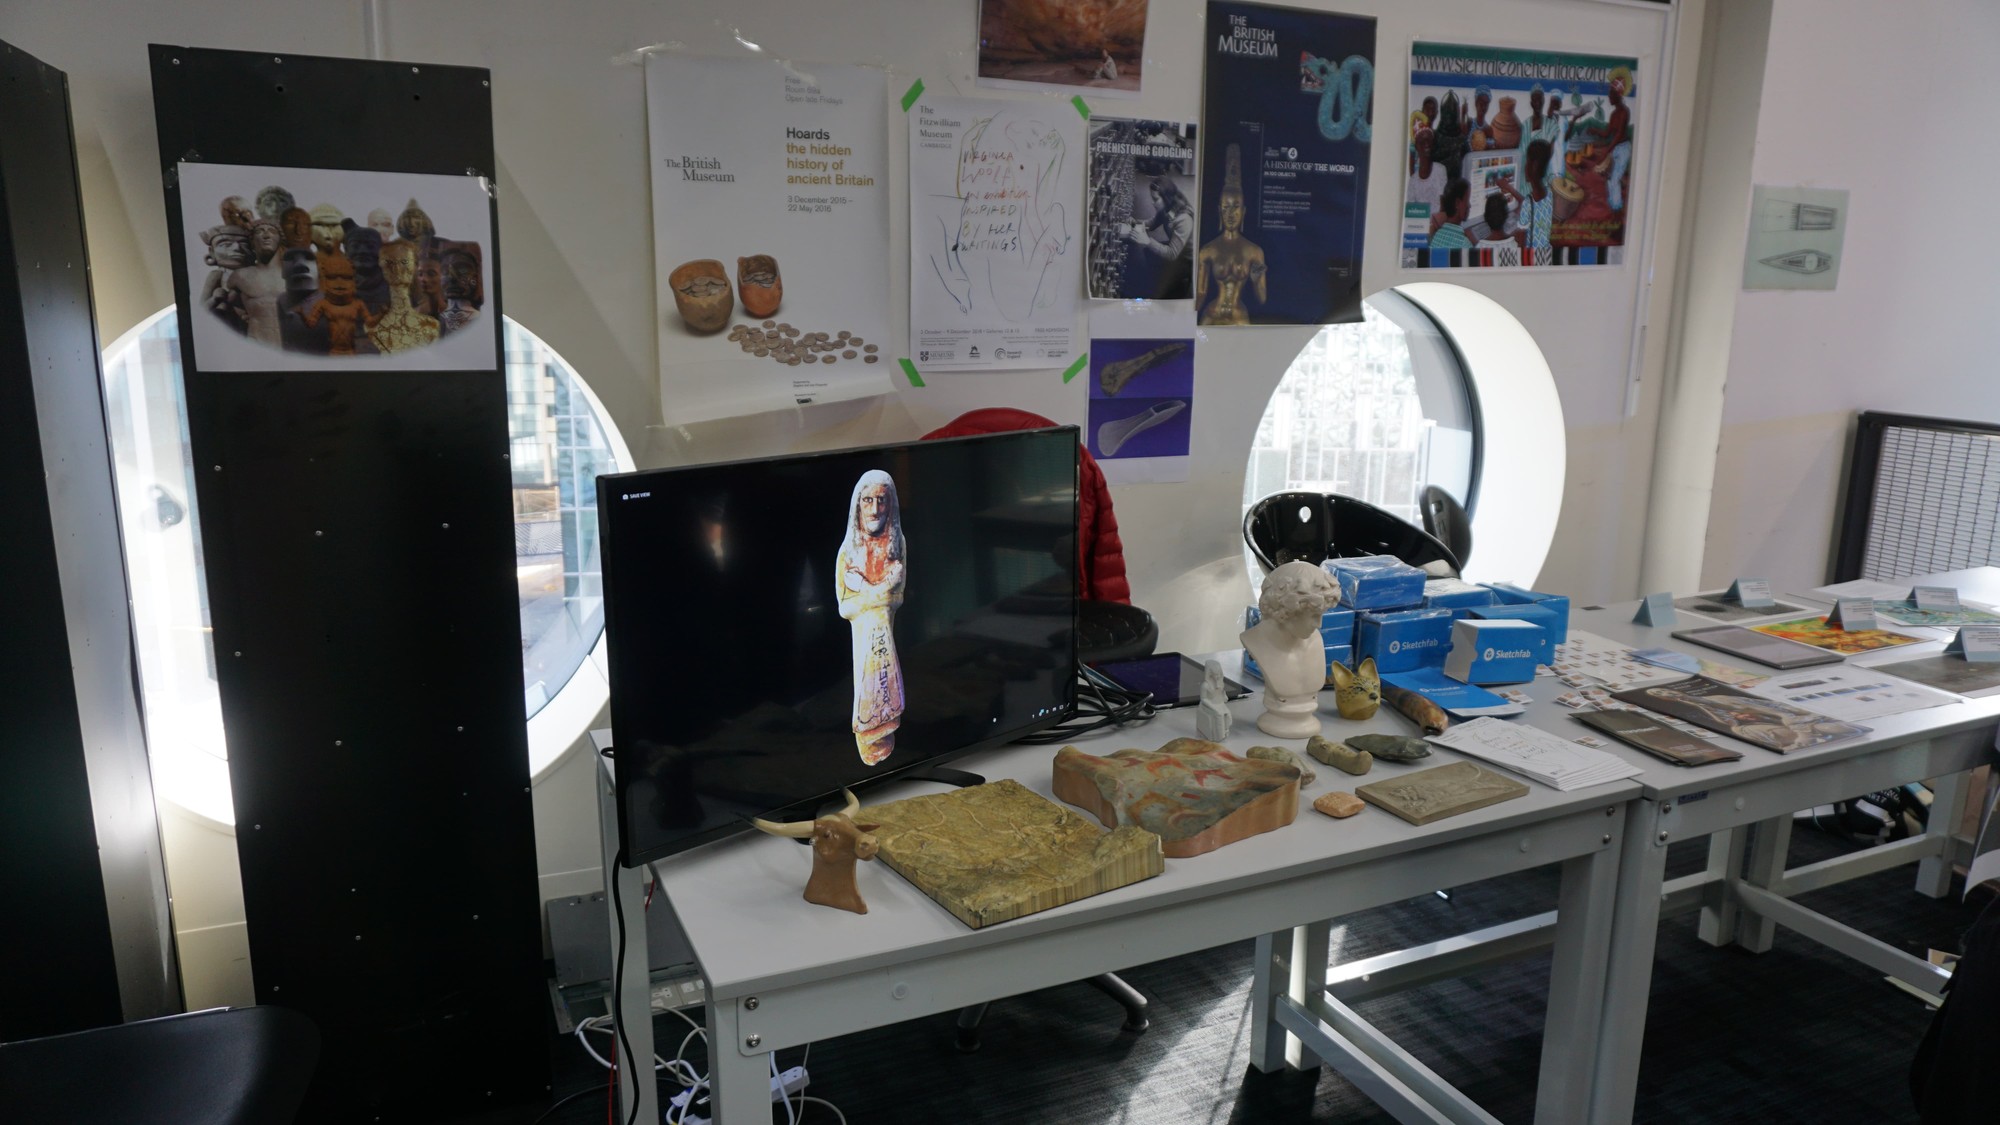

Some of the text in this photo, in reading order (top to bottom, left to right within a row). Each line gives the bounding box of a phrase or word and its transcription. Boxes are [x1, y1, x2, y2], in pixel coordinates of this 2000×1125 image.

[1229, 14, 1247, 27] THE
[1234, 26, 1275, 42] BRITISH
[1218, 34, 1278, 57] MUSEUM
[1416, 52, 1606, 85] www.sierraleoneheritage.org
[784, 76, 801, 84] Free
[785, 85, 806, 94] Room
[785, 94, 804, 104] Open
[819, 95, 844, 106] Fridays
[920, 105, 934, 114] The
[919, 117, 961, 127] Fitzwilliam
[786, 127, 831, 140] Hoards
[920, 129, 952, 138] Museum
[786, 142, 852, 156] the hidden
[1096, 141, 1193, 159] PREHISTORIC GOOGLING
[664, 155, 722, 169] The British
[787, 157, 844, 172] history of
[1263, 160, 1355, 173] A HISTORY OF THE WORLD
[682, 168, 735, 182] Museum
[787, 173, 874, 186] ancient Britain
[787, 195, 793, 203] 3
[794, 195, 828, 204] December
[830, 196, 847, 205] 2015
[787, 204, 832, 214] 22 May 2016
[1402, 638, 1439, 651] Sketchfab
[1495, 648, 1531, 660] Sketchfab
